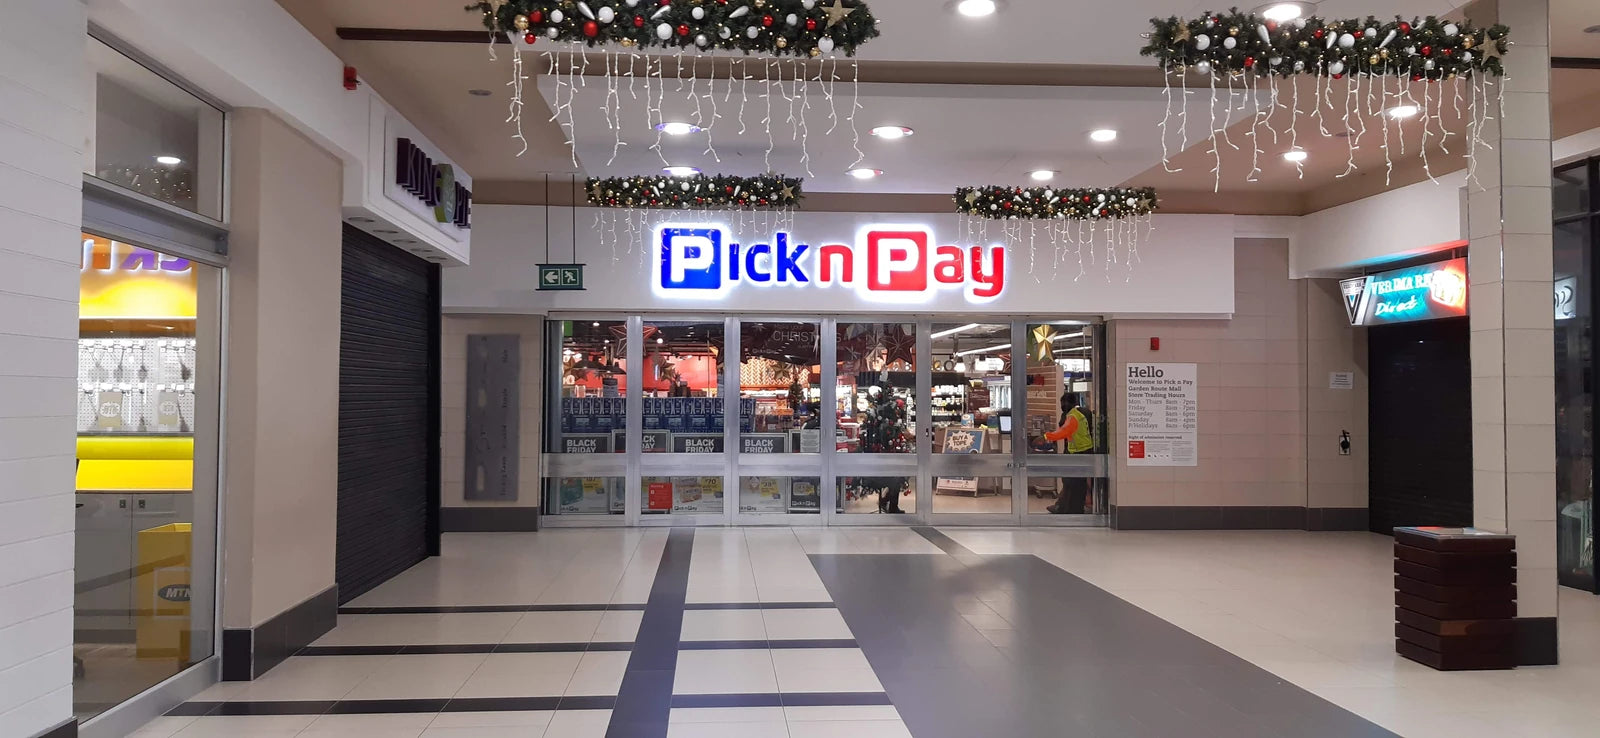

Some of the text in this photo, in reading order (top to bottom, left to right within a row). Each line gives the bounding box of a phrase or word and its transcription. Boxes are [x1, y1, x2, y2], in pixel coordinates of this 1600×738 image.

[661, 228, 1005, 297] Pick n Pay
[1375, 295, 1418, 316] Direct
[772, 330, 842, 343] CHRISTS
[1128, 366, 1164, 378] Hello
[567, 439, 596, 447] BLACK
[686, 438, 715, 446] BLACK
[745, 438, 774, 446] BLACK
